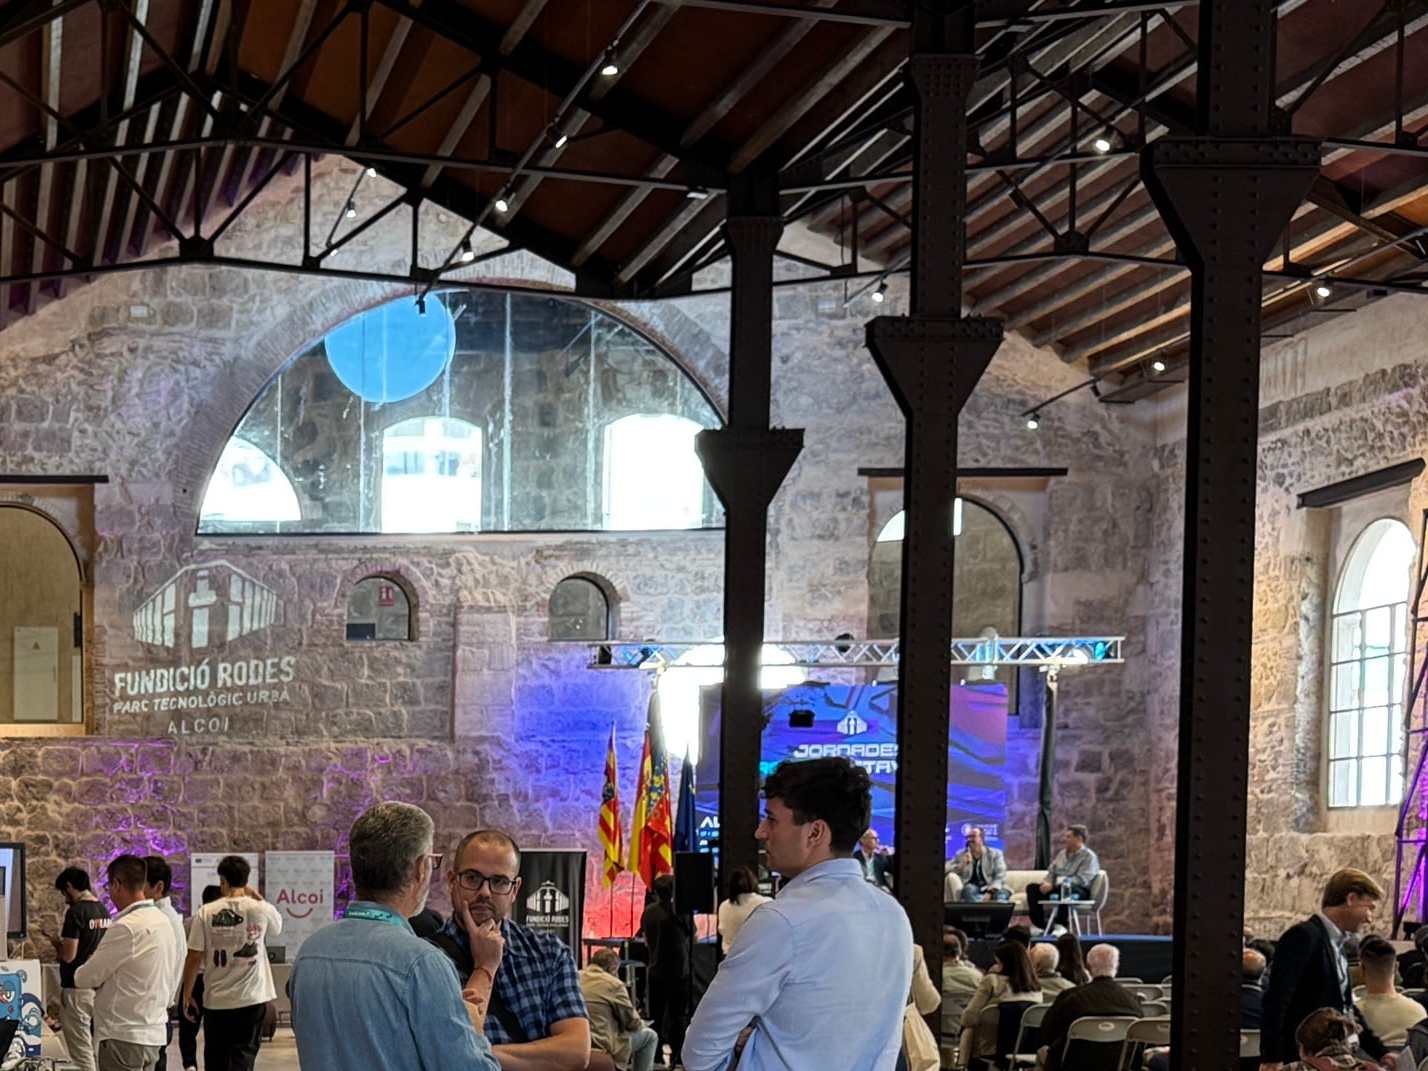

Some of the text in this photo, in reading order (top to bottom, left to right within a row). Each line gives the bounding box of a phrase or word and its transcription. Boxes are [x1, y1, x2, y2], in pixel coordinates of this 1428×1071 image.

[114, 656, 296, 696] FUNDICIÓ RODES
[113, 686, 290, 714] PARC TECNOLÒGIC URBÀ
[167, 717, 229, 734] ALCOI
[277, 889, 324, 904] Alcoi
